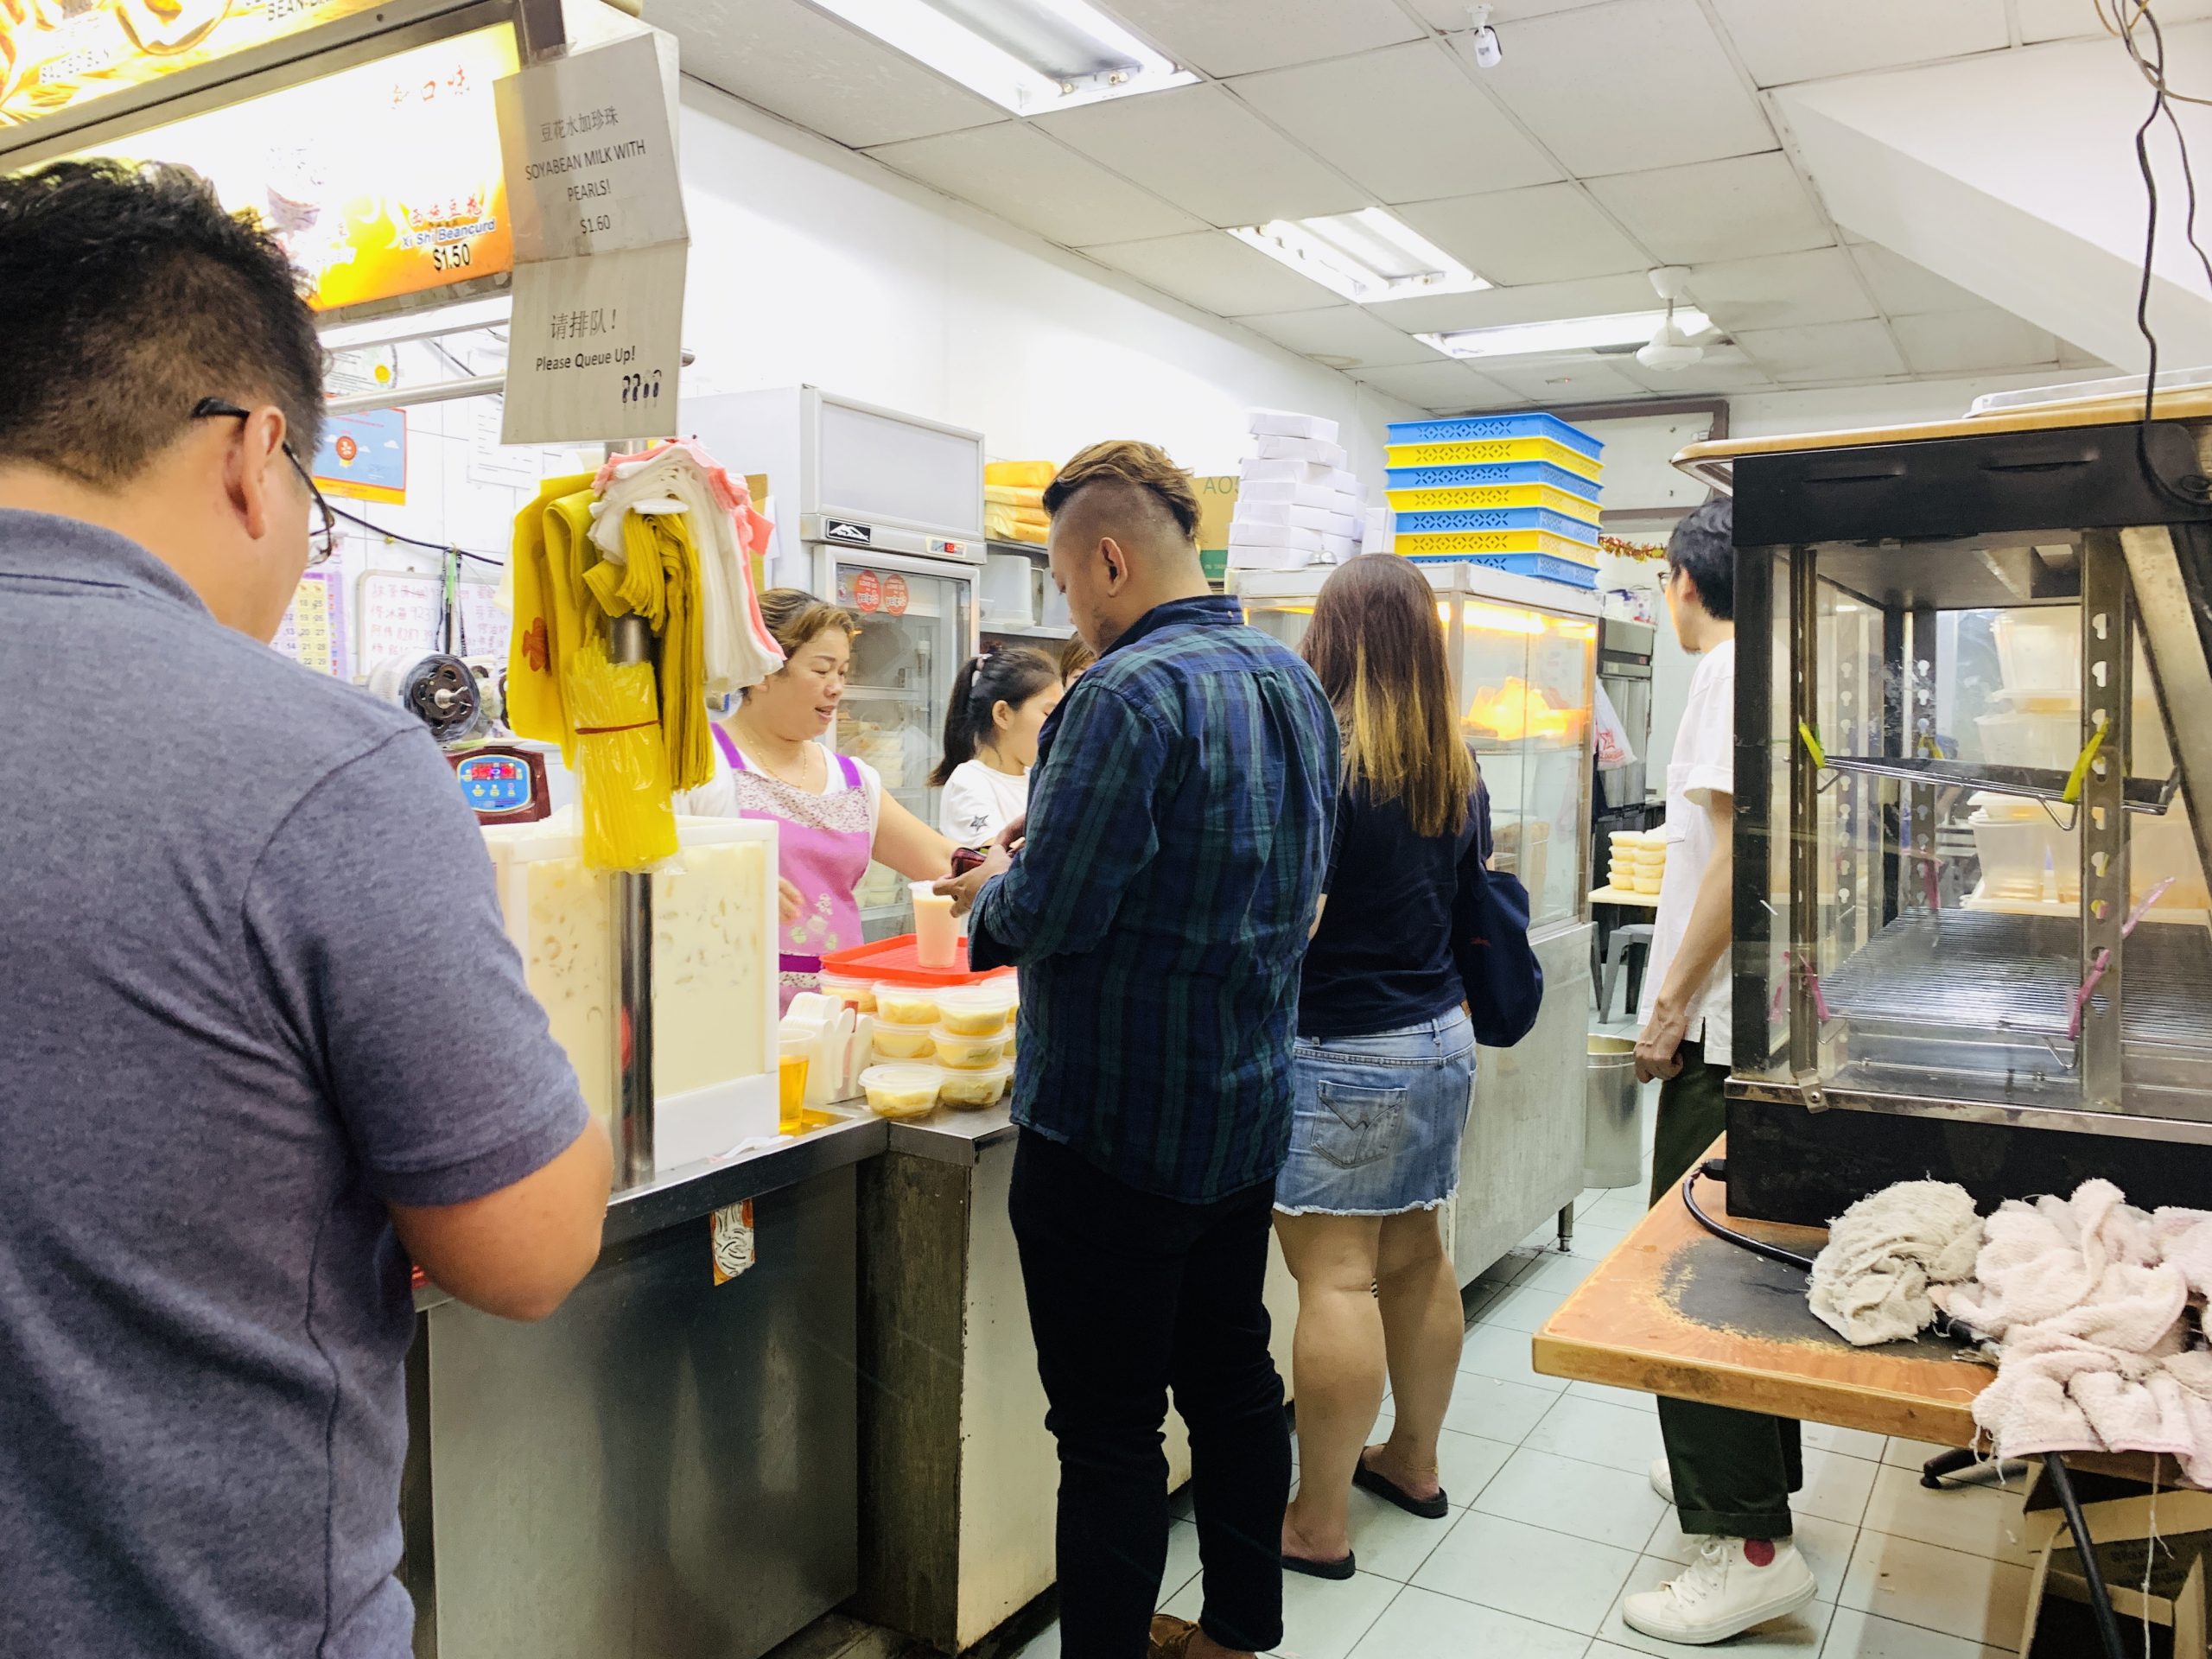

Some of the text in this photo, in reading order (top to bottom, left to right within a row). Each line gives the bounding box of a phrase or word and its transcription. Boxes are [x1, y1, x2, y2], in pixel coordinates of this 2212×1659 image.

[541, 105, 619, 143] 豆花水加珍珠
[525, 139, 646, 181] SOYABEAN MILK WITH
[568, 178, 612, 202] PEARLS!
[403, 236, 413, 248] Xi
[416, 229, 436, 245] Shi
[438, 219, 496, 241] Beancurd
[580, 214, 611, 234] $1.60
[433, 244, 470, 271] $1.50
[550, 308, 617, 340] 请排队！
[536, 345, 636, 372] Please Queue Up!
